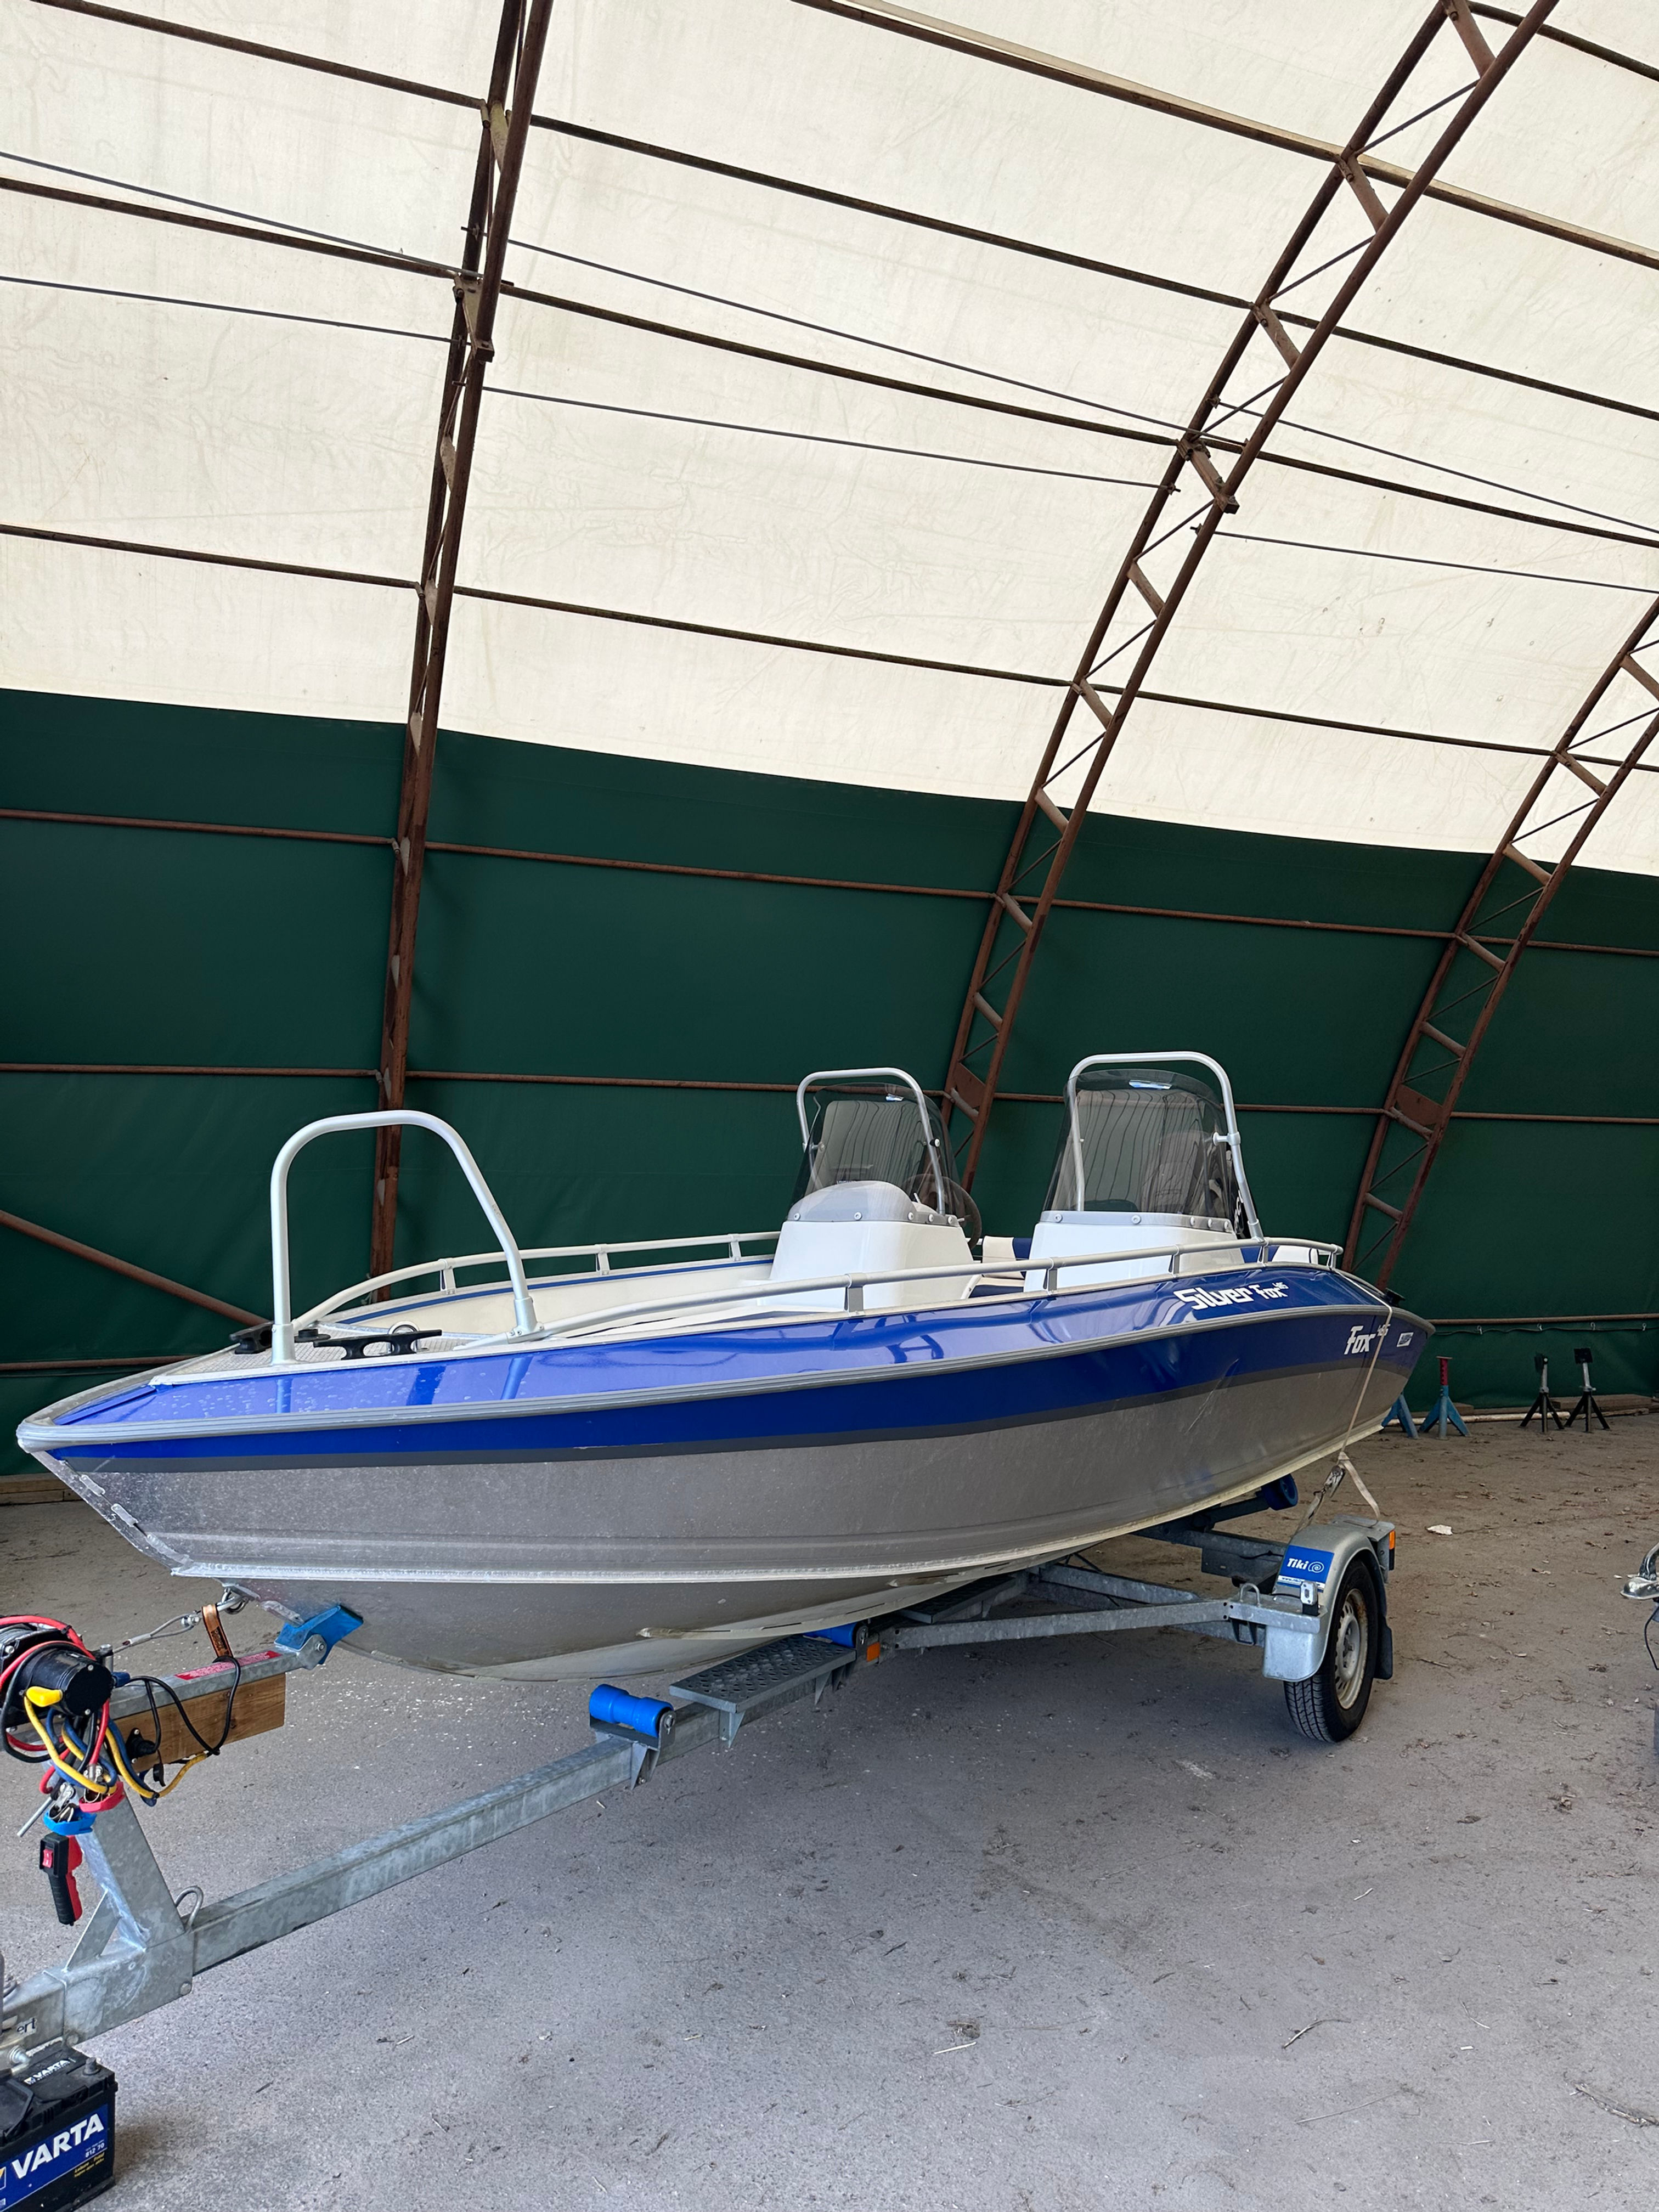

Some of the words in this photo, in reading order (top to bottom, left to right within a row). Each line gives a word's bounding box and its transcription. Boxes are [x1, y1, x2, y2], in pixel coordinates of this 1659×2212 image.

[1173, 1287, 1254, 1310] Silver
[1344, 1325, 1376, 1355] Fox
[1287, 1558, 1309, 1570] Tiki
[12, 2113, 104, 2179] VARTA
